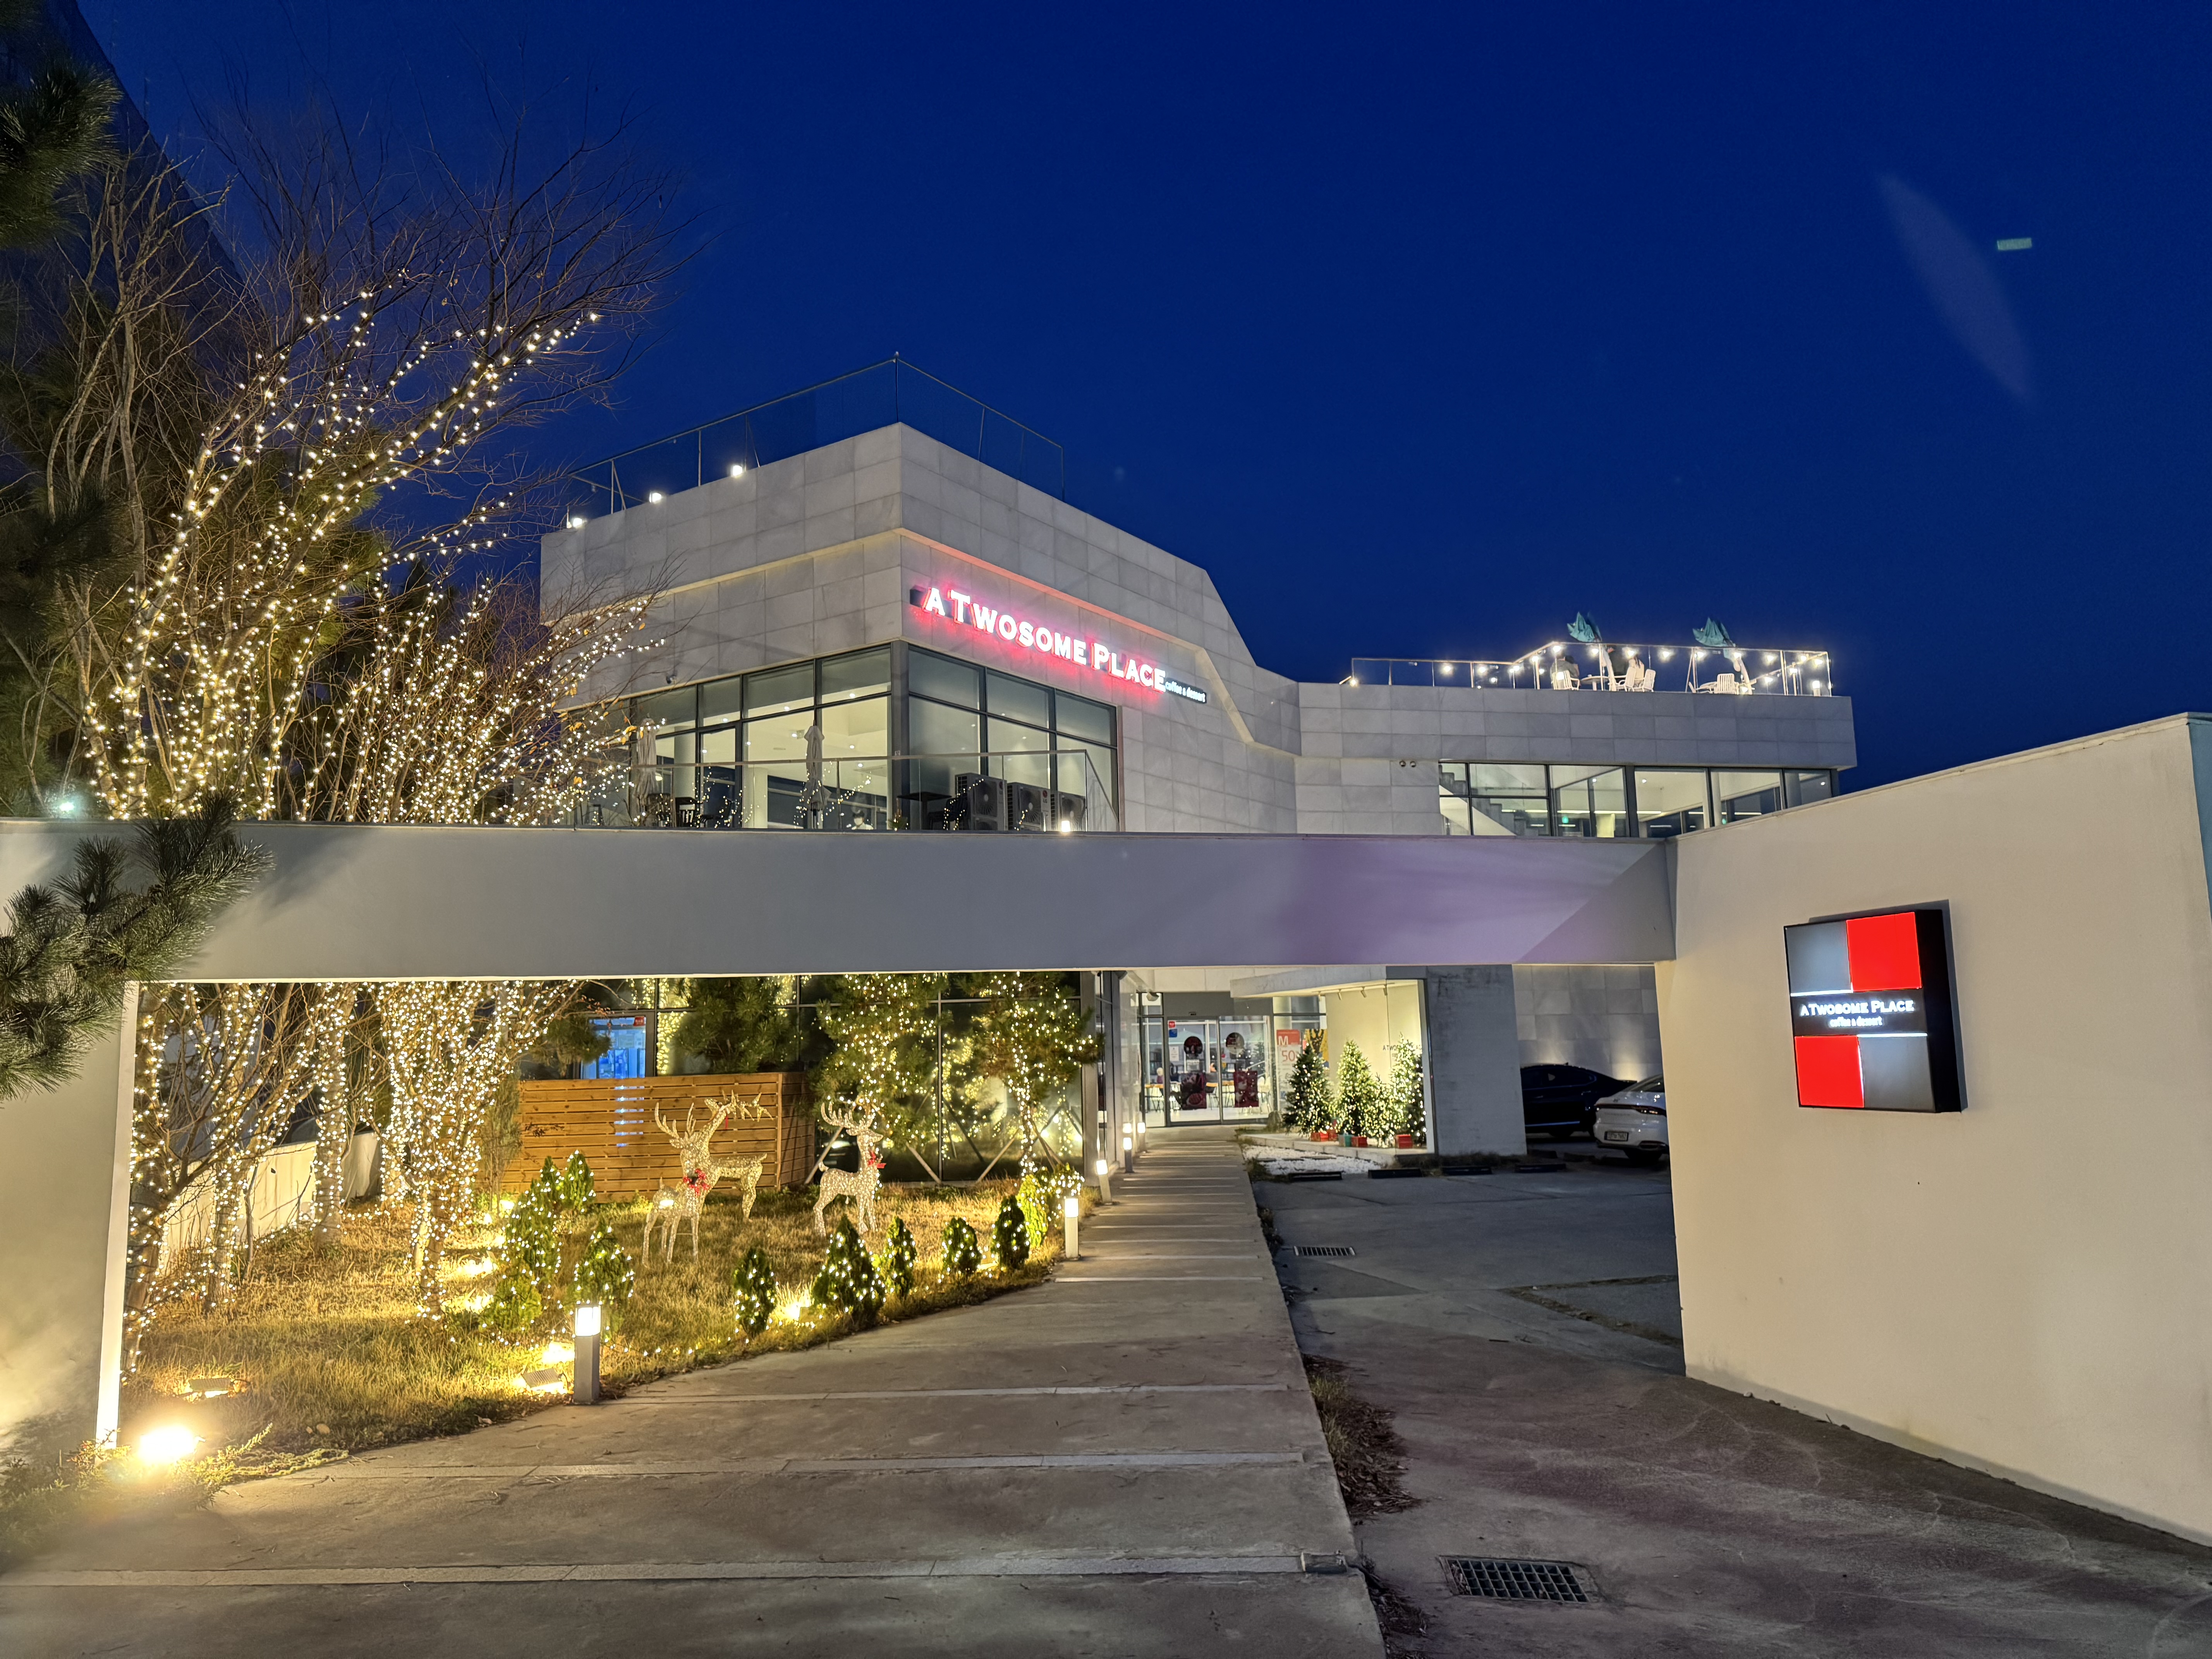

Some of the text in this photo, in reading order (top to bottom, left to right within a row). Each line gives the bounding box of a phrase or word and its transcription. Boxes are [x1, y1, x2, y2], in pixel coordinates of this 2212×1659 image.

[923, 587, 1166, 693] A TWOSOME PLACE
[1801, 1000, 1914, 1016] A TWOSOME PLACE
